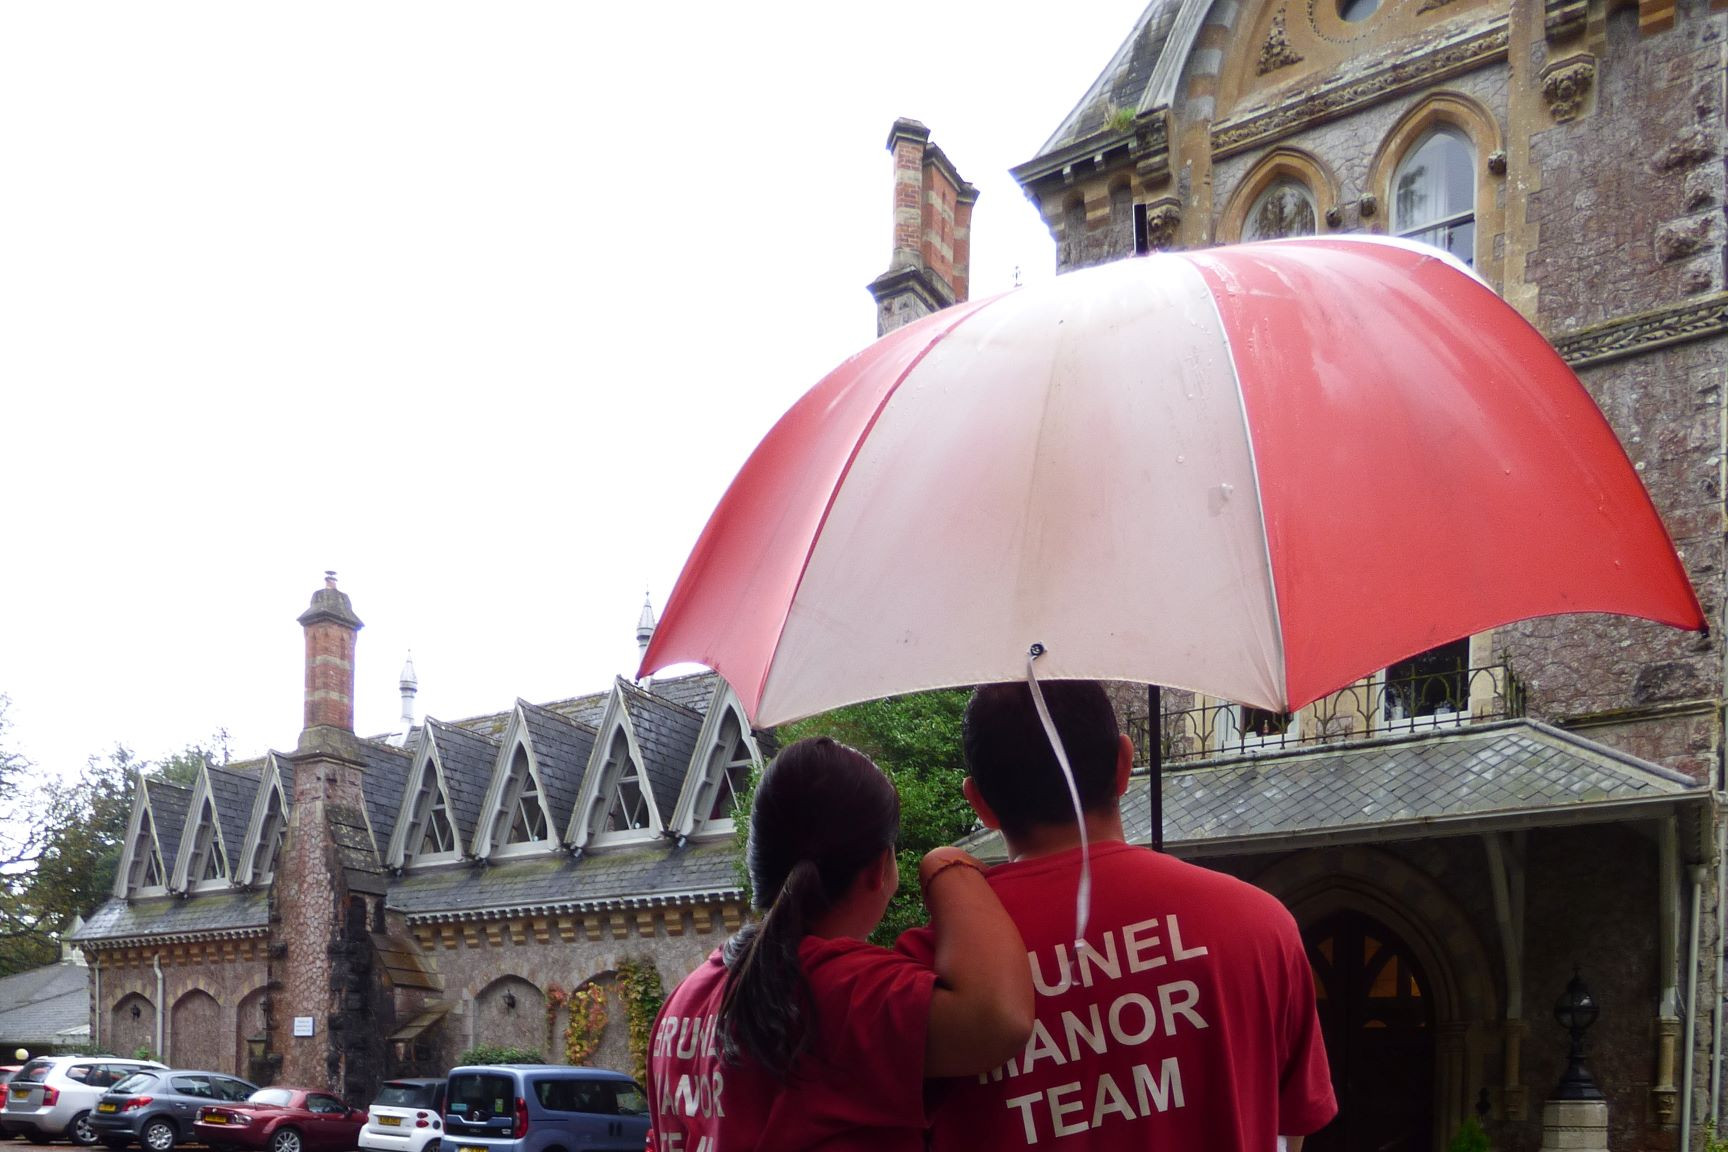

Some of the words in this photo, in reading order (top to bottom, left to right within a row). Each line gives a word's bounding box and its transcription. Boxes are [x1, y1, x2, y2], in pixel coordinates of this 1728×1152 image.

[1028, 914, 1208, 996] UNEL
[653, 1014, 718, 1059] BRUN
[978, 980, 1209, 1084] ANOR
[1006, 1057, 1185, 1145] TEAM
